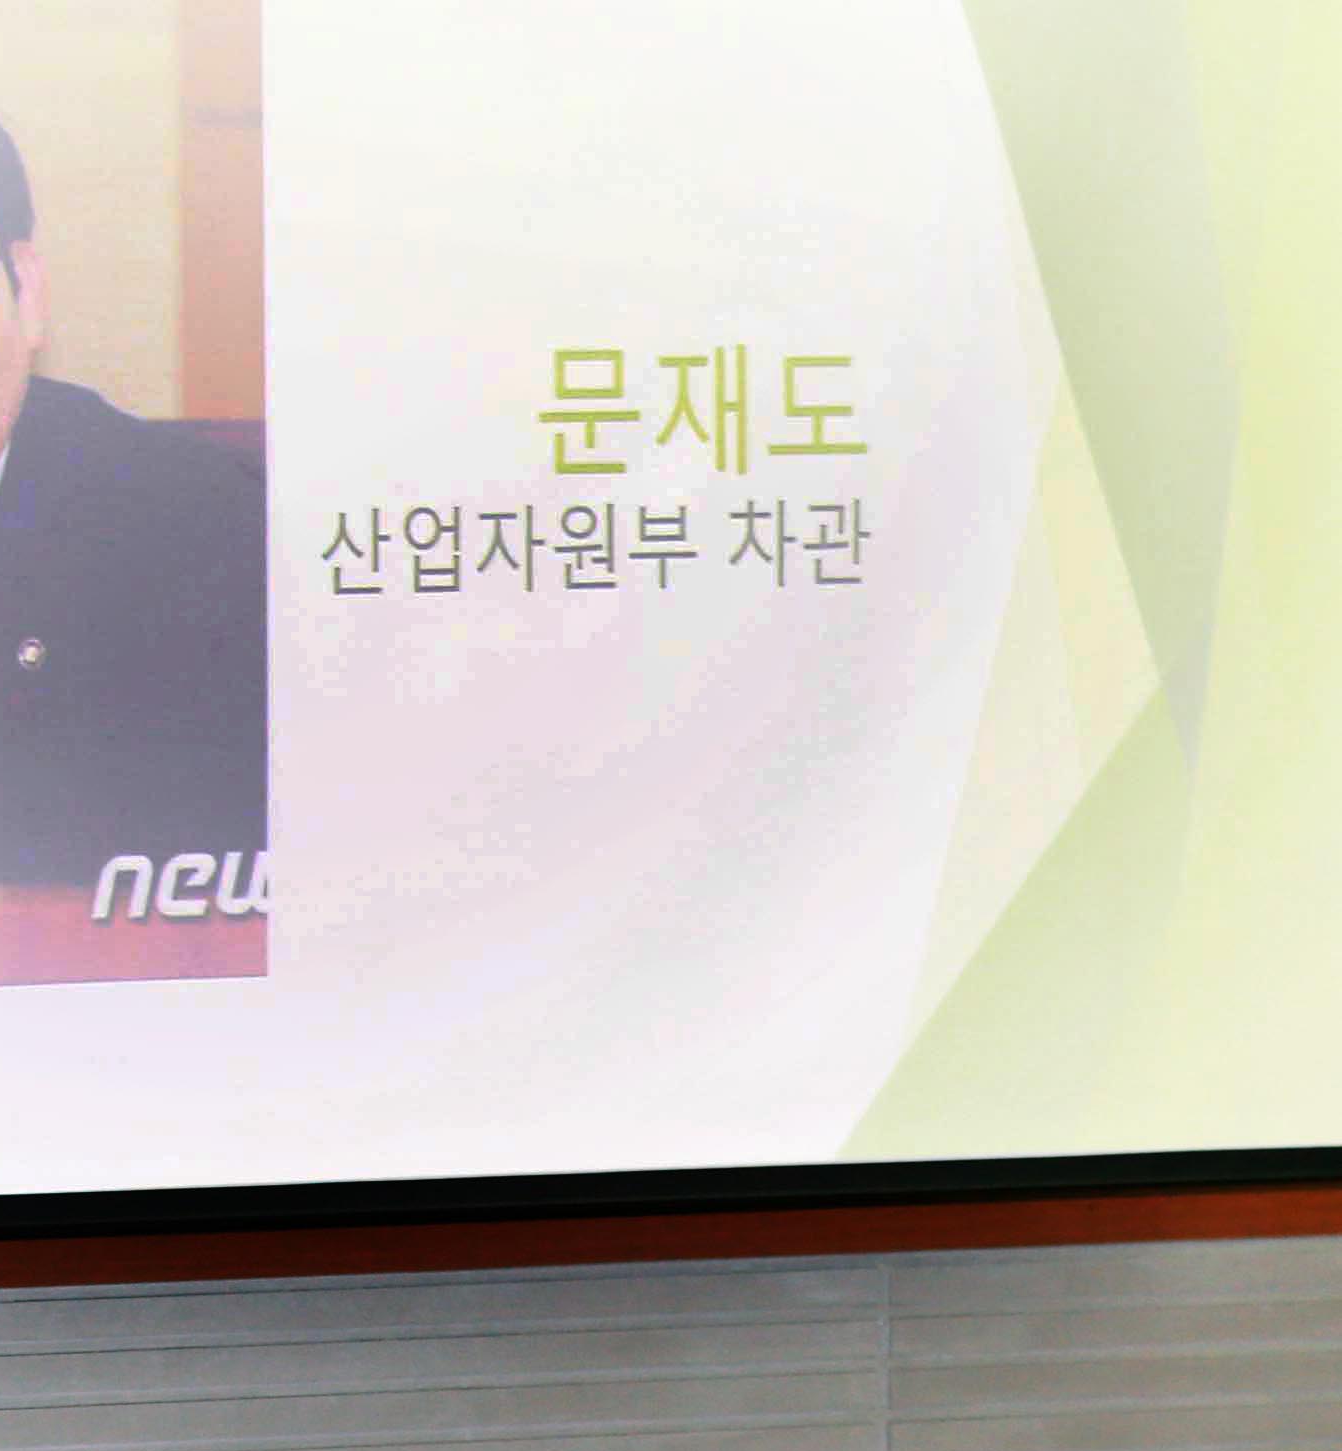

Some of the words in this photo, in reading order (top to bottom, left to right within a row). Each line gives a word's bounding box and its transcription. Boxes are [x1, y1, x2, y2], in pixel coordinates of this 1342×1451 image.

[538, 344, 869, 475] 문재도
[321, 502, 699, 596] 산업자원부
[727, 498, 871, 588] 차관
